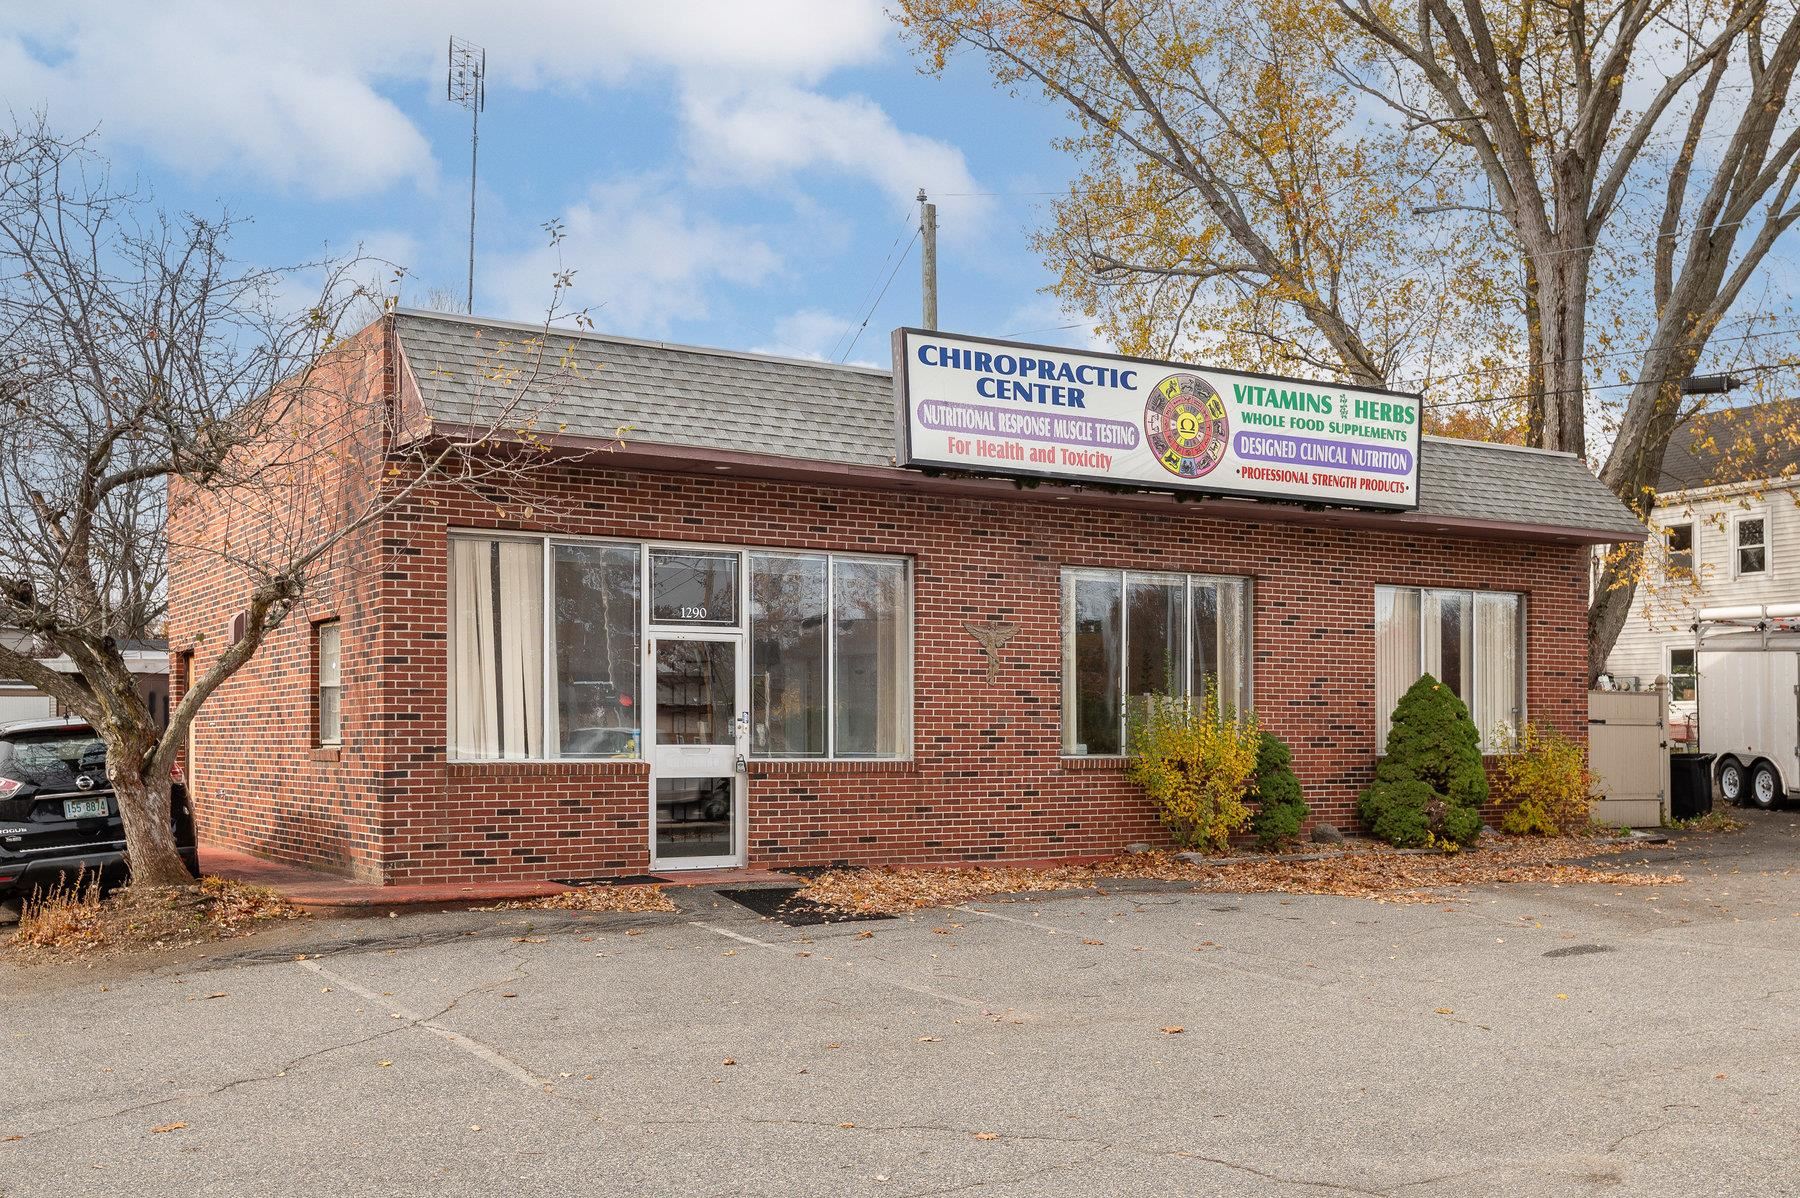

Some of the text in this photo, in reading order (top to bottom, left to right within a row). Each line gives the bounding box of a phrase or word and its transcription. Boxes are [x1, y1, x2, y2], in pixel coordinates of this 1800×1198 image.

[918, 344, 1138, 391] CHIROPRACTIC
[976, 377, 1086, 409] CENTER
[1233, 383, 1415, 425] VITAMINS HERBS
[923, 404, 1136, 446] NUTRITIONAL RESPONSE MUSCLE TESTING
[1241, 411, 1408, 442] WHOLE FOOD SUPPLEMENTS
[947, 436, 1113, 472] For Health and Toxicity
[1241, 436, 1407, 471] DESIGNED CLINICAL NUTRITION
[1241, 466, 1405, 494] PROFESSIONAL STRENGTH PRODUCTS
[680, 606, 707, 619] 1290
[67, 802, 82, 813] 155
